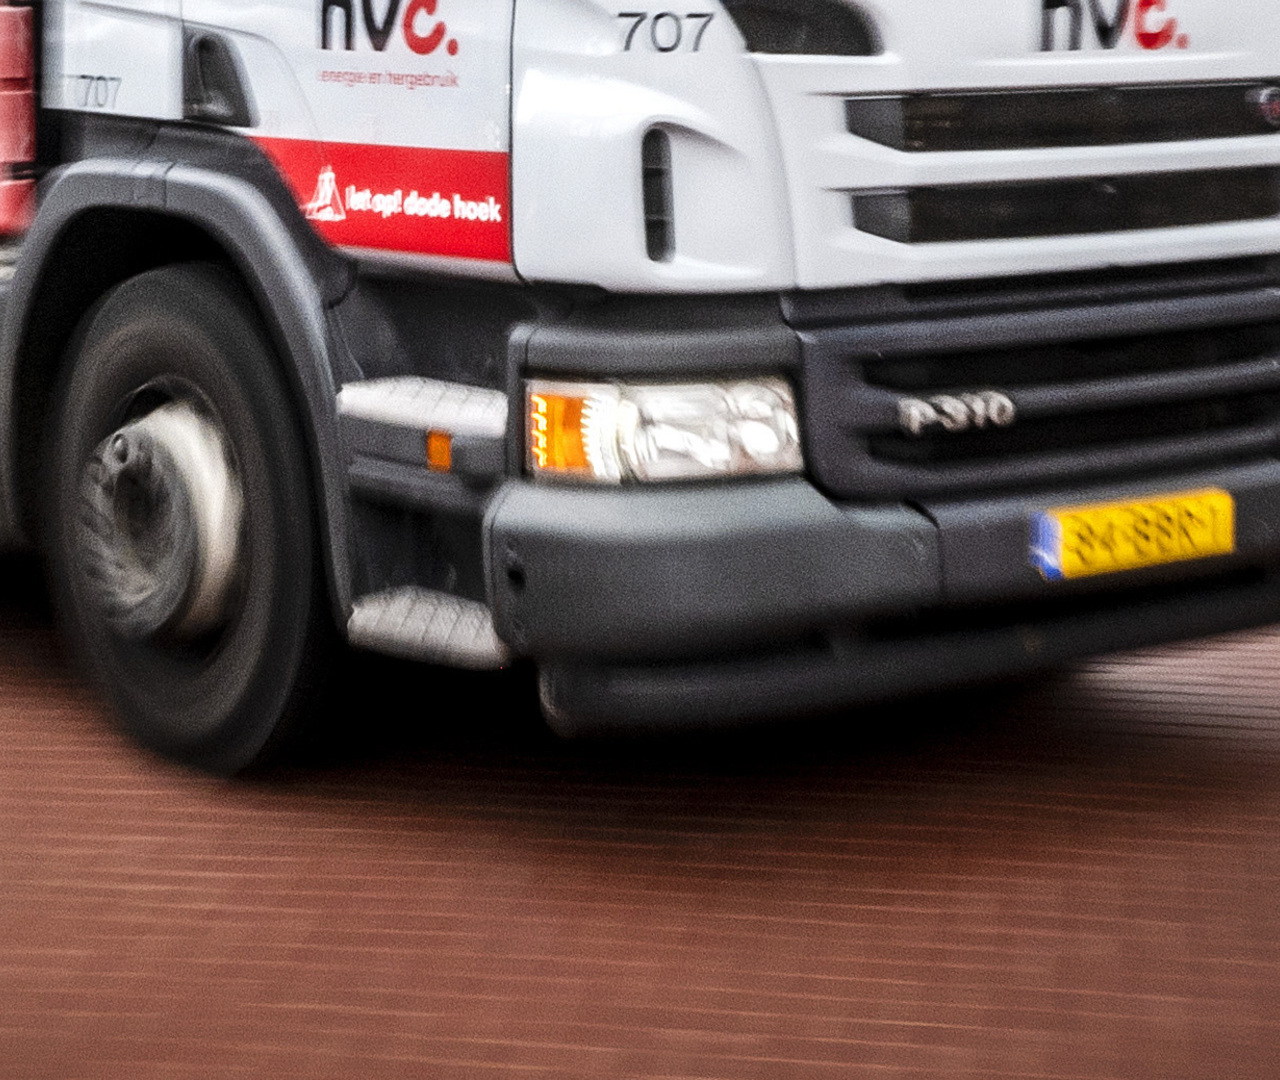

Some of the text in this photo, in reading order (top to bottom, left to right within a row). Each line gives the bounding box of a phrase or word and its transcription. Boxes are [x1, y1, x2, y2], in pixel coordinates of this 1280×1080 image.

[617, 11, 715, 53] 707
[78, 73, 123, 109] 707
[372, 189, 403, 219] op!
[403, 189, 452, 219] dode
[453, 193, 502, 223] hoek
[897, 390, 1016, 435] P310
